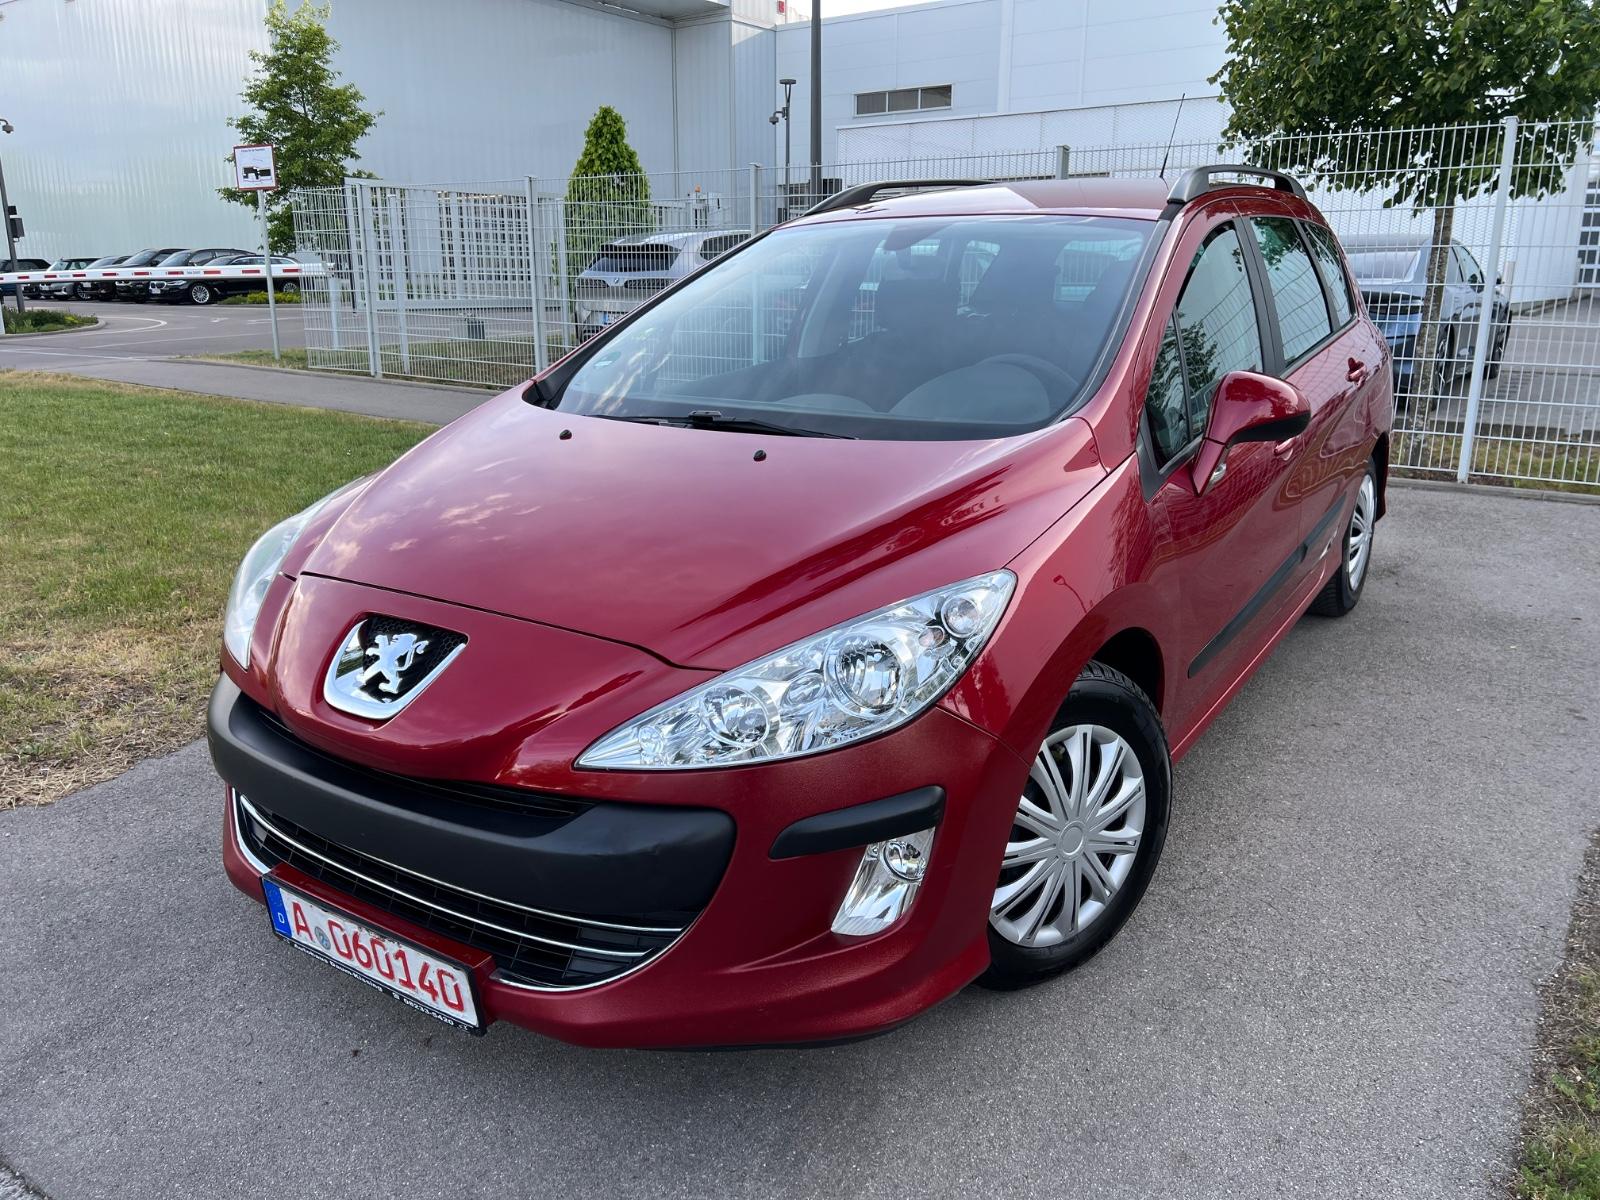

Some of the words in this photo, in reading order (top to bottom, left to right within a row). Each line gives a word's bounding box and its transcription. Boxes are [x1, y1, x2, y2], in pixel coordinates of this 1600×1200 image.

[278, 912, 285, 924] D
[292, 901, 314, 941] A
[327, 919, 464, 1012] 060140
